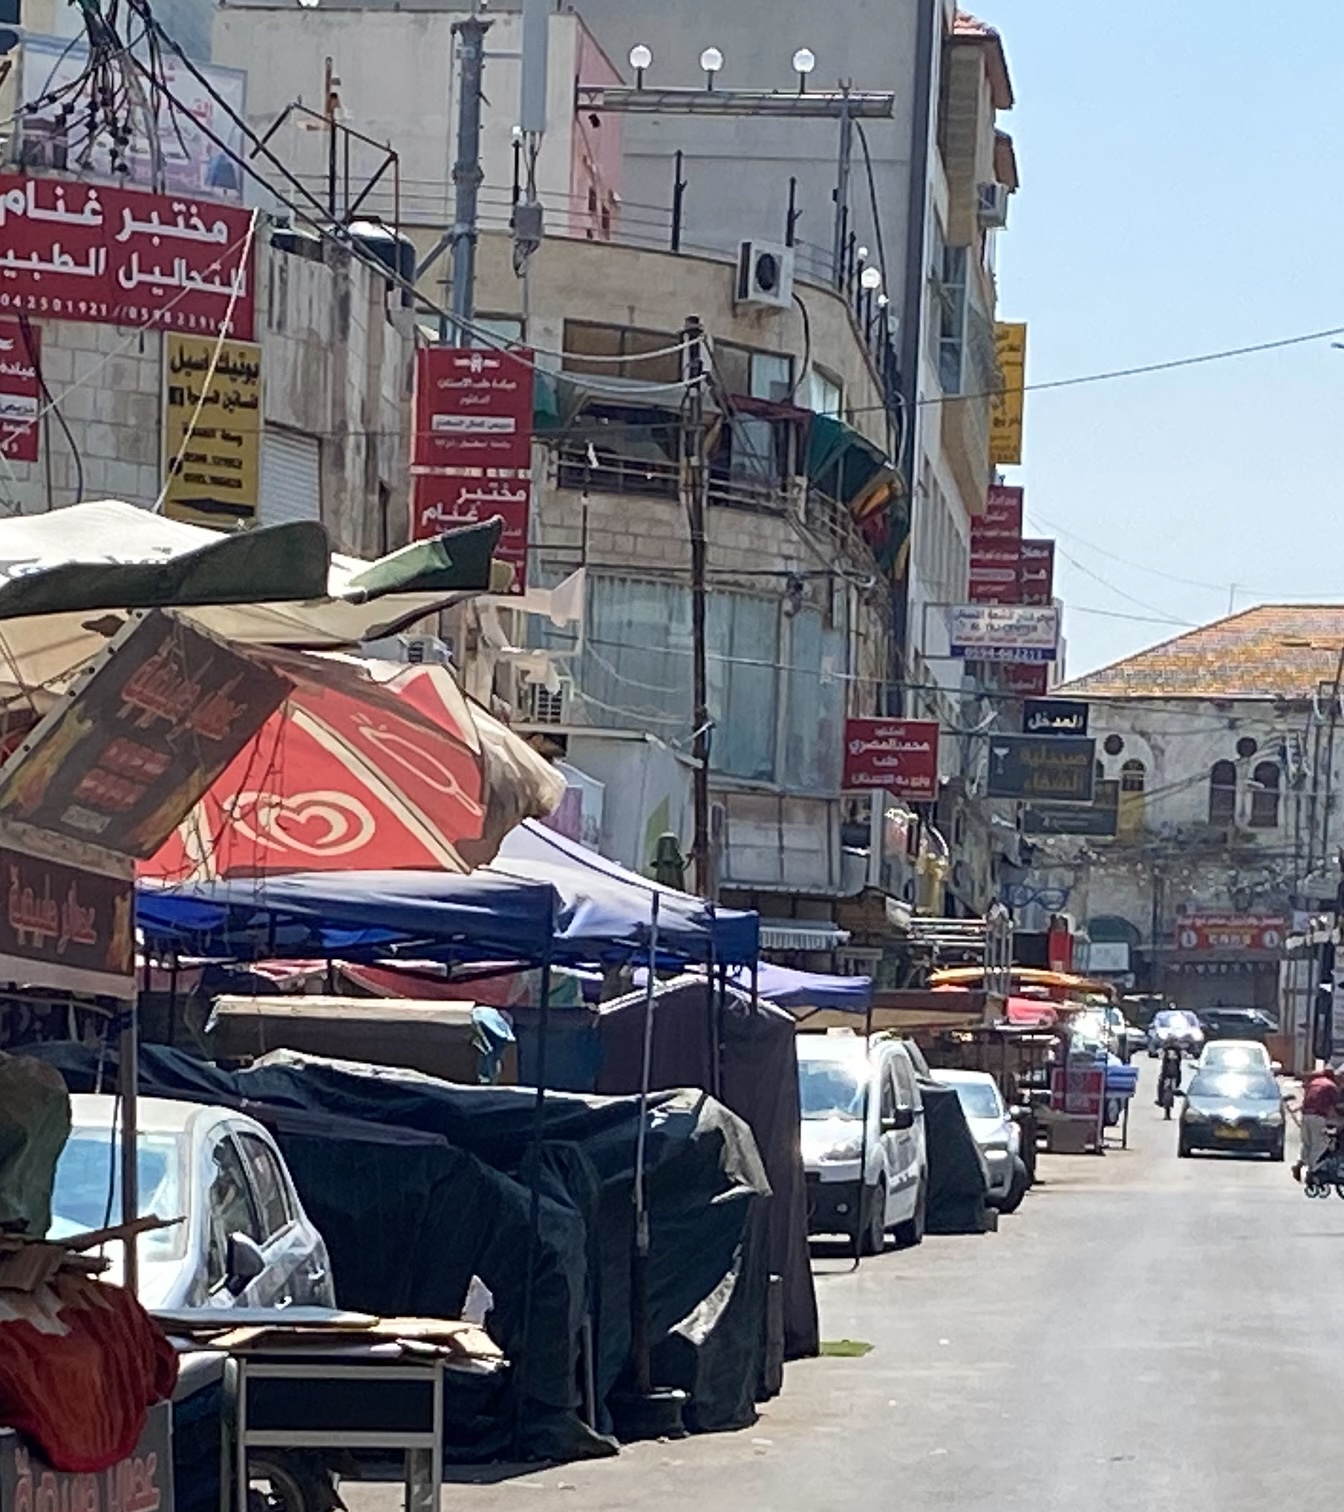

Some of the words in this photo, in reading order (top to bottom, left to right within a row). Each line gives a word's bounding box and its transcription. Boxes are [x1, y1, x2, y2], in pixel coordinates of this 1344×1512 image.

[115, 202, 230, 246] مختبر
[118, 252, 248, 298] للتحاليل
[456, 481, 527, 505] مختبر
[421, 501, 480, 527] غنام
